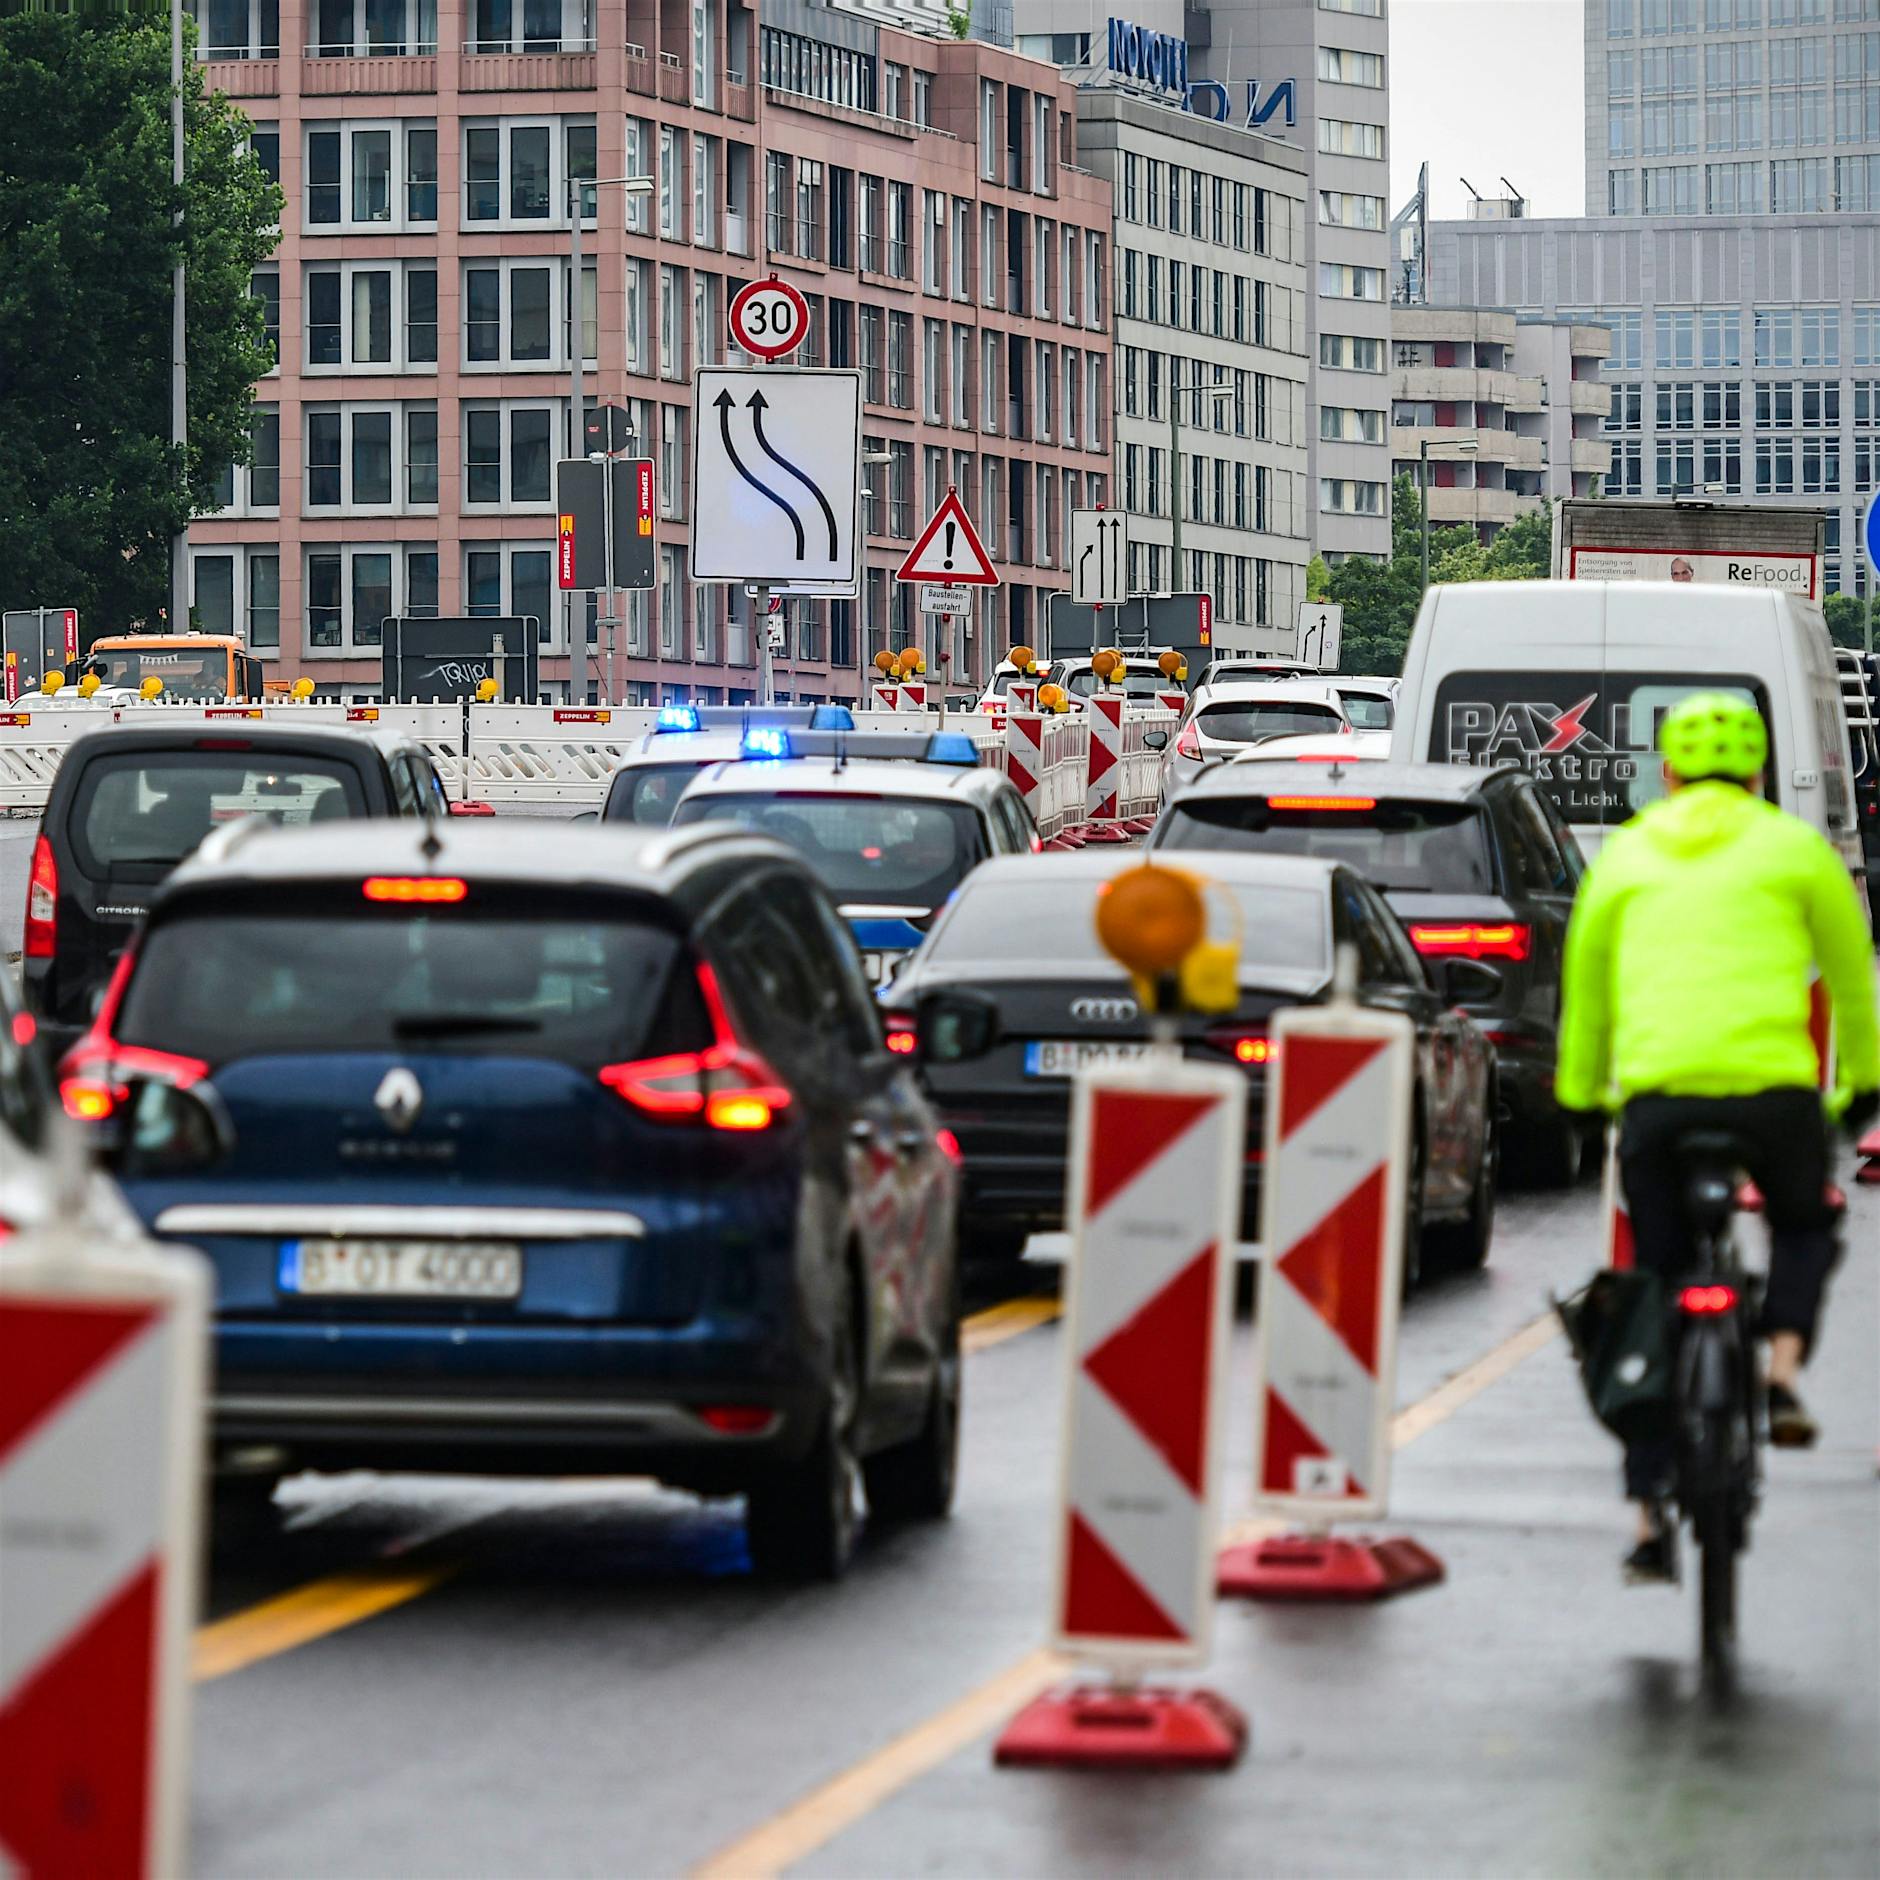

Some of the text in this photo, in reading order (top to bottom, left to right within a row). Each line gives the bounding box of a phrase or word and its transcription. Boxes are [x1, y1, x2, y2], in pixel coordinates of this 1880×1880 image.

[1108, 17, 1188, 93] NOVOTEL
[747, 301, 791, 335] 30
[1728, 563, 1801, 582] ReFood
[928, 588, 967, 600] Baustellen-
[932, 602, 961, 612] ausfahrt
